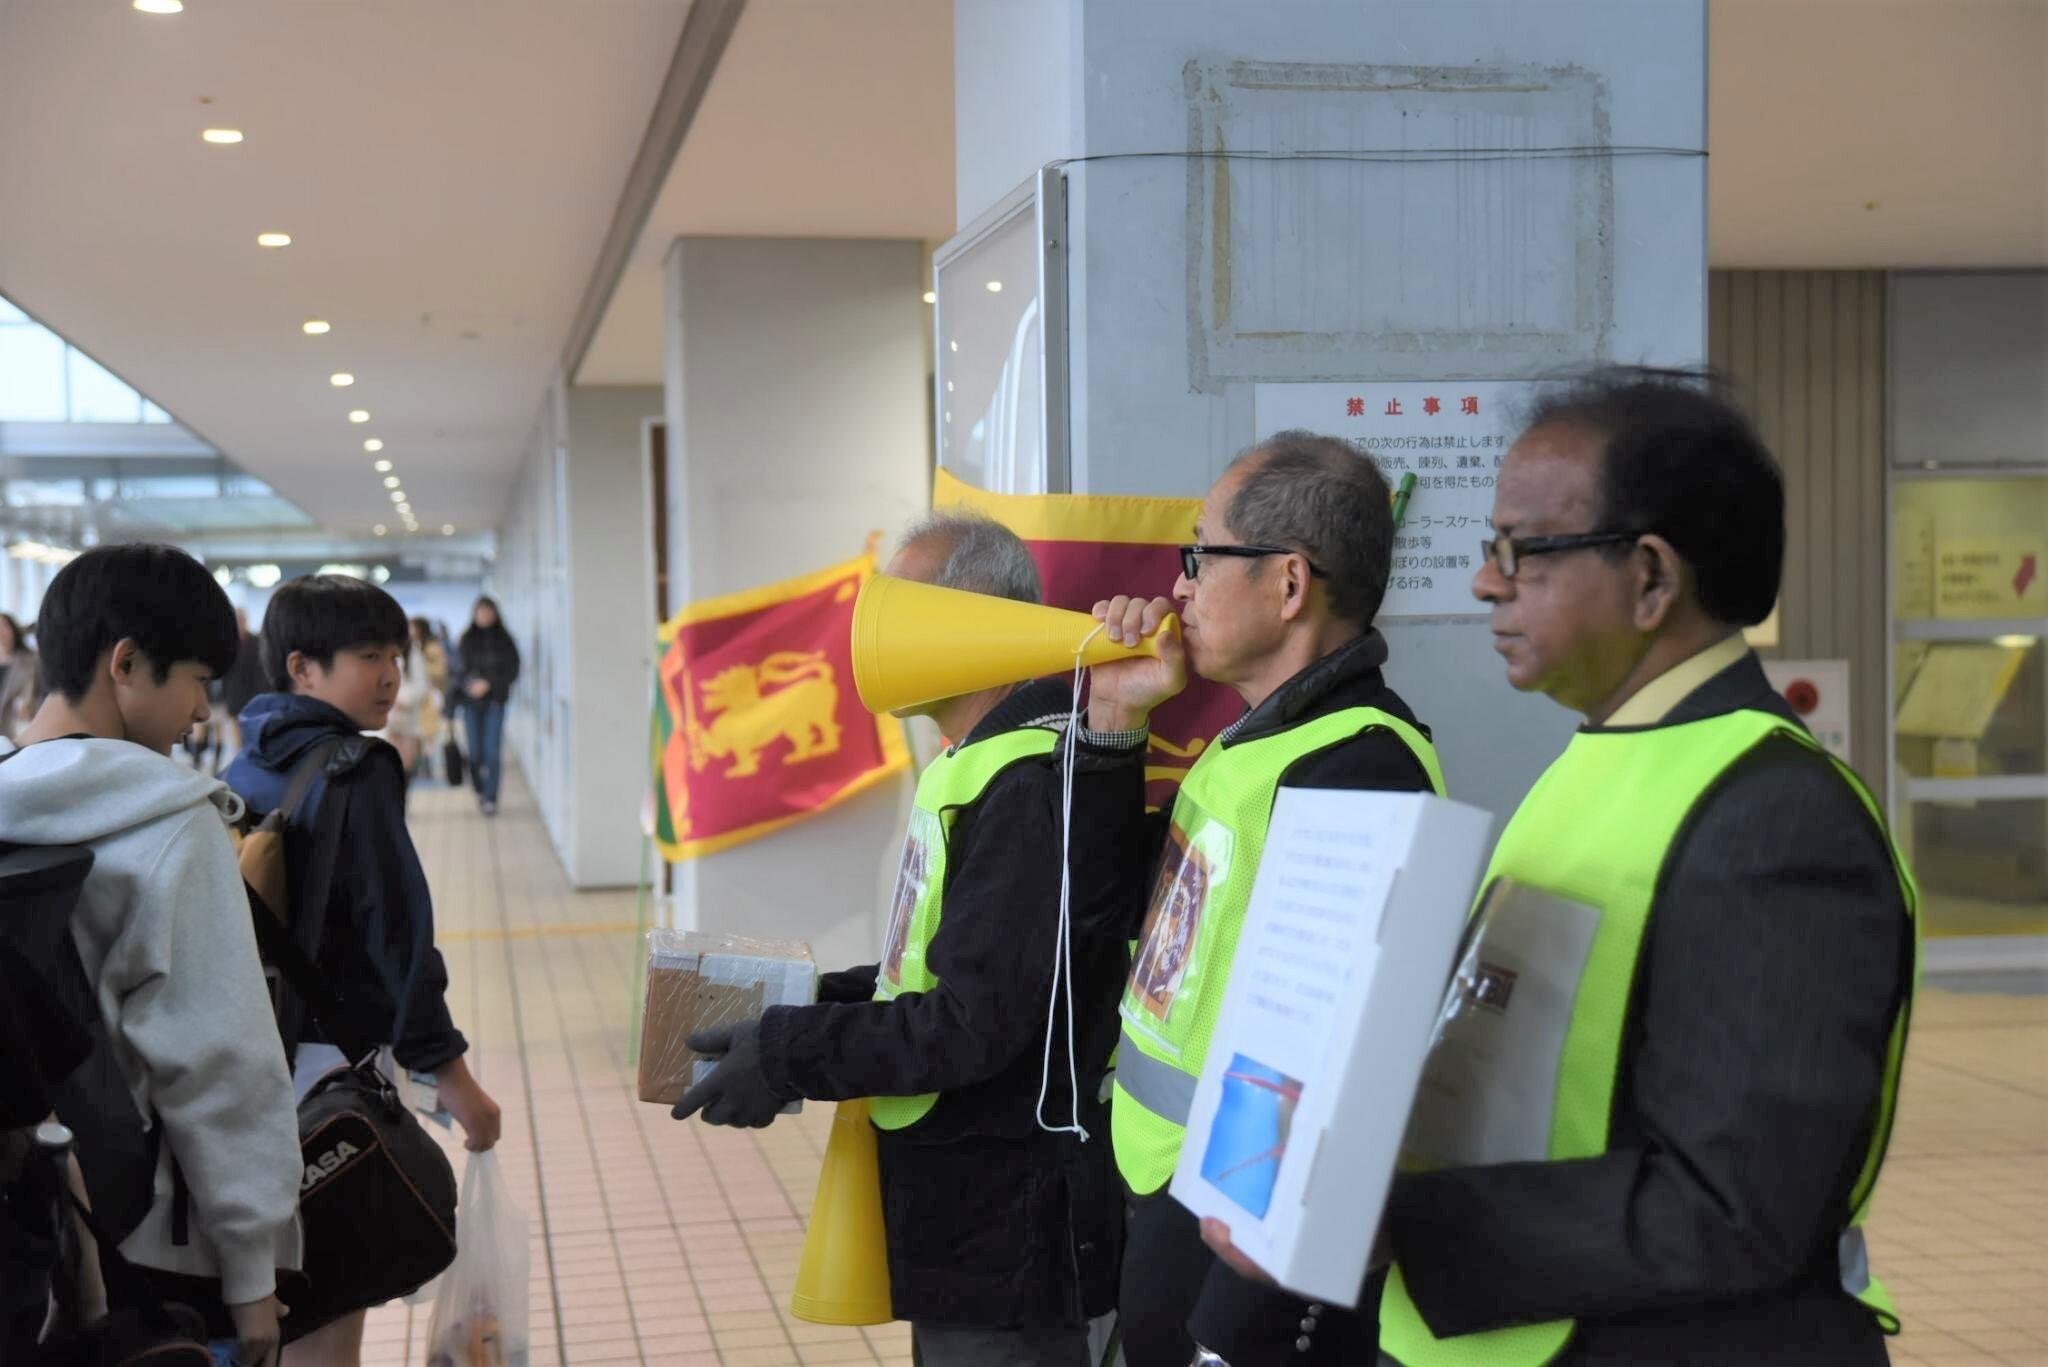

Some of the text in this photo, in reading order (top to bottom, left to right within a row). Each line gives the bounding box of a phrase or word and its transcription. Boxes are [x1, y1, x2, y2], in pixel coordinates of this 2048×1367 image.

[1346, 396, 1479, 417] 禁止事項
[1345, 435, 1504, 449] での次の行為は禁止します
[1376, 455, 1502, 470] 販売、陳列、遺棄、
[1415, 476, 1498, 489] 可を得たもの
